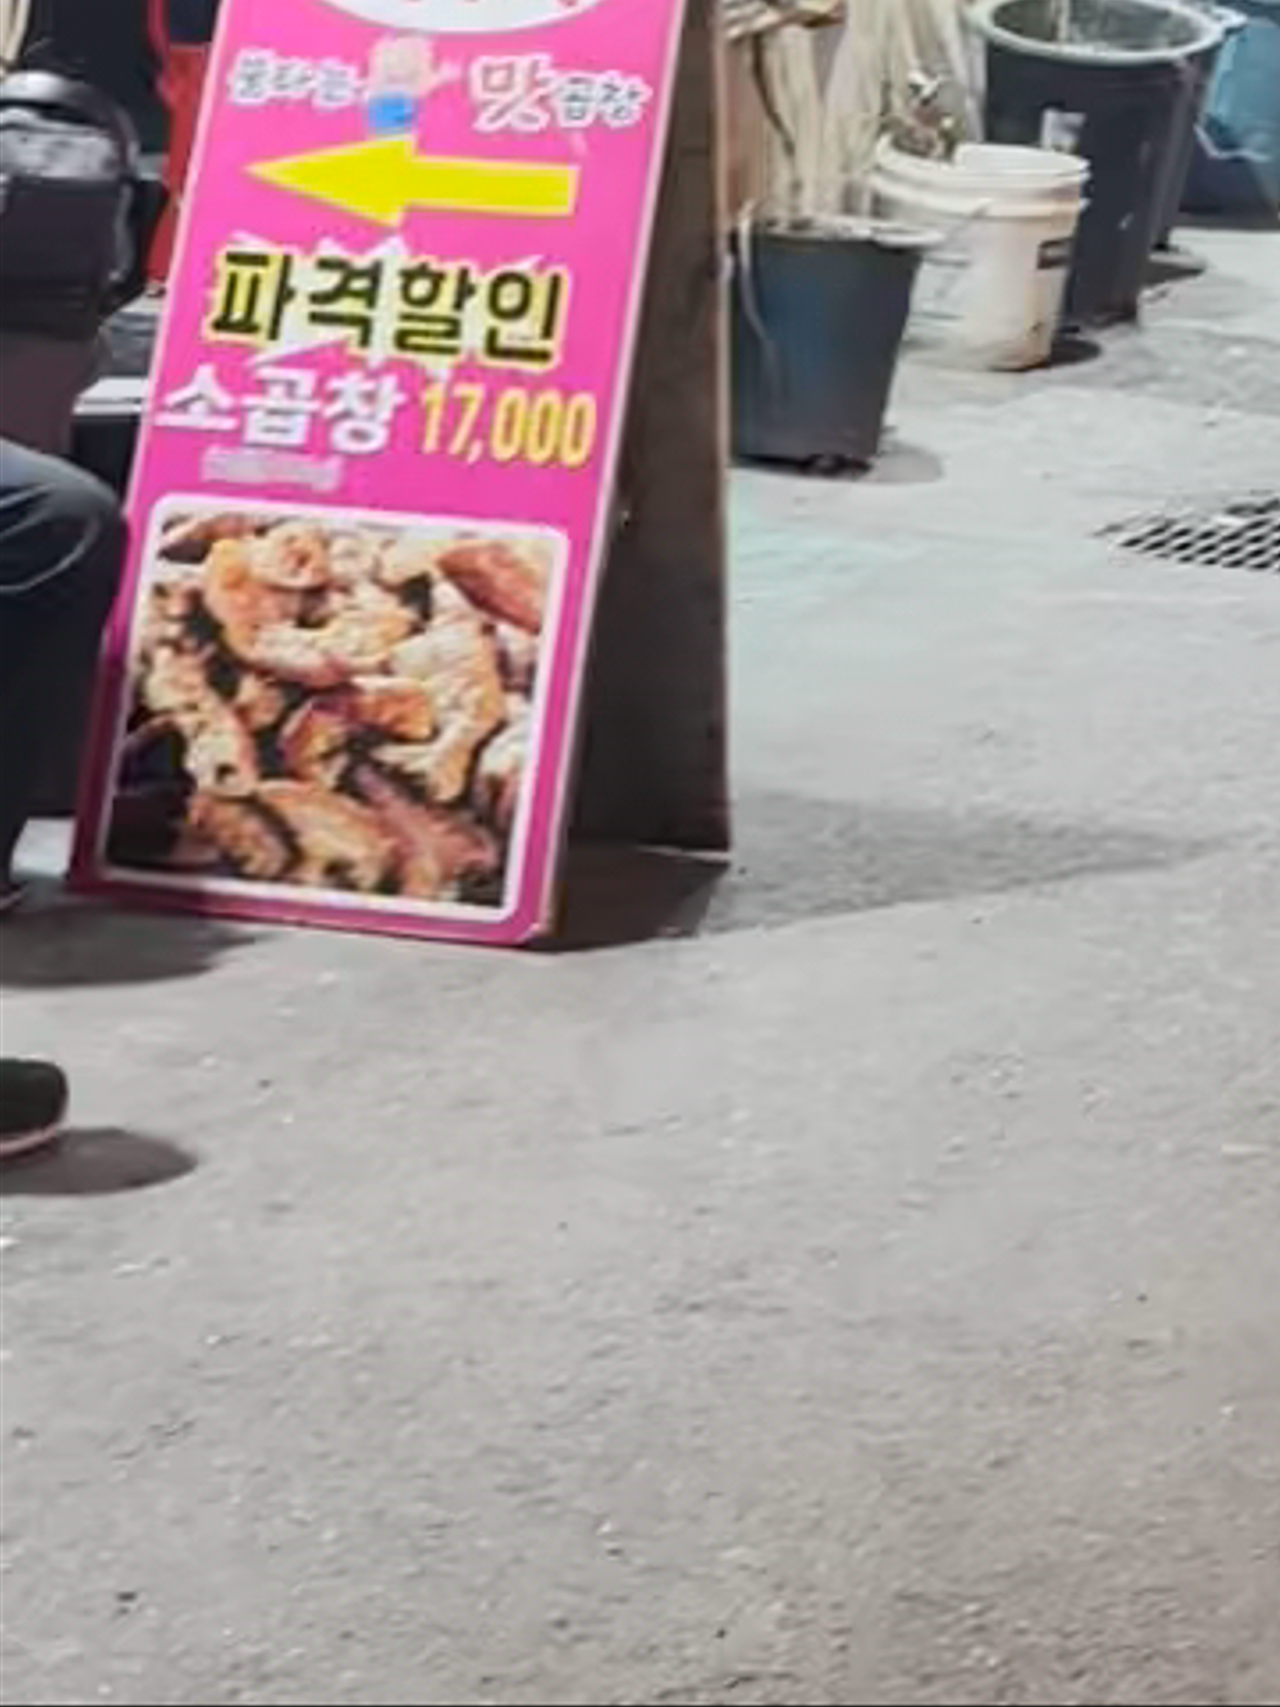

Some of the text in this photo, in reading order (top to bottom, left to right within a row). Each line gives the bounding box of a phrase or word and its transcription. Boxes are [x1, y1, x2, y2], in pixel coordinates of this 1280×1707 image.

[212, 250, 564, 363] 파격할인
[154, 364, 598, 468] 소곱창 17,000
